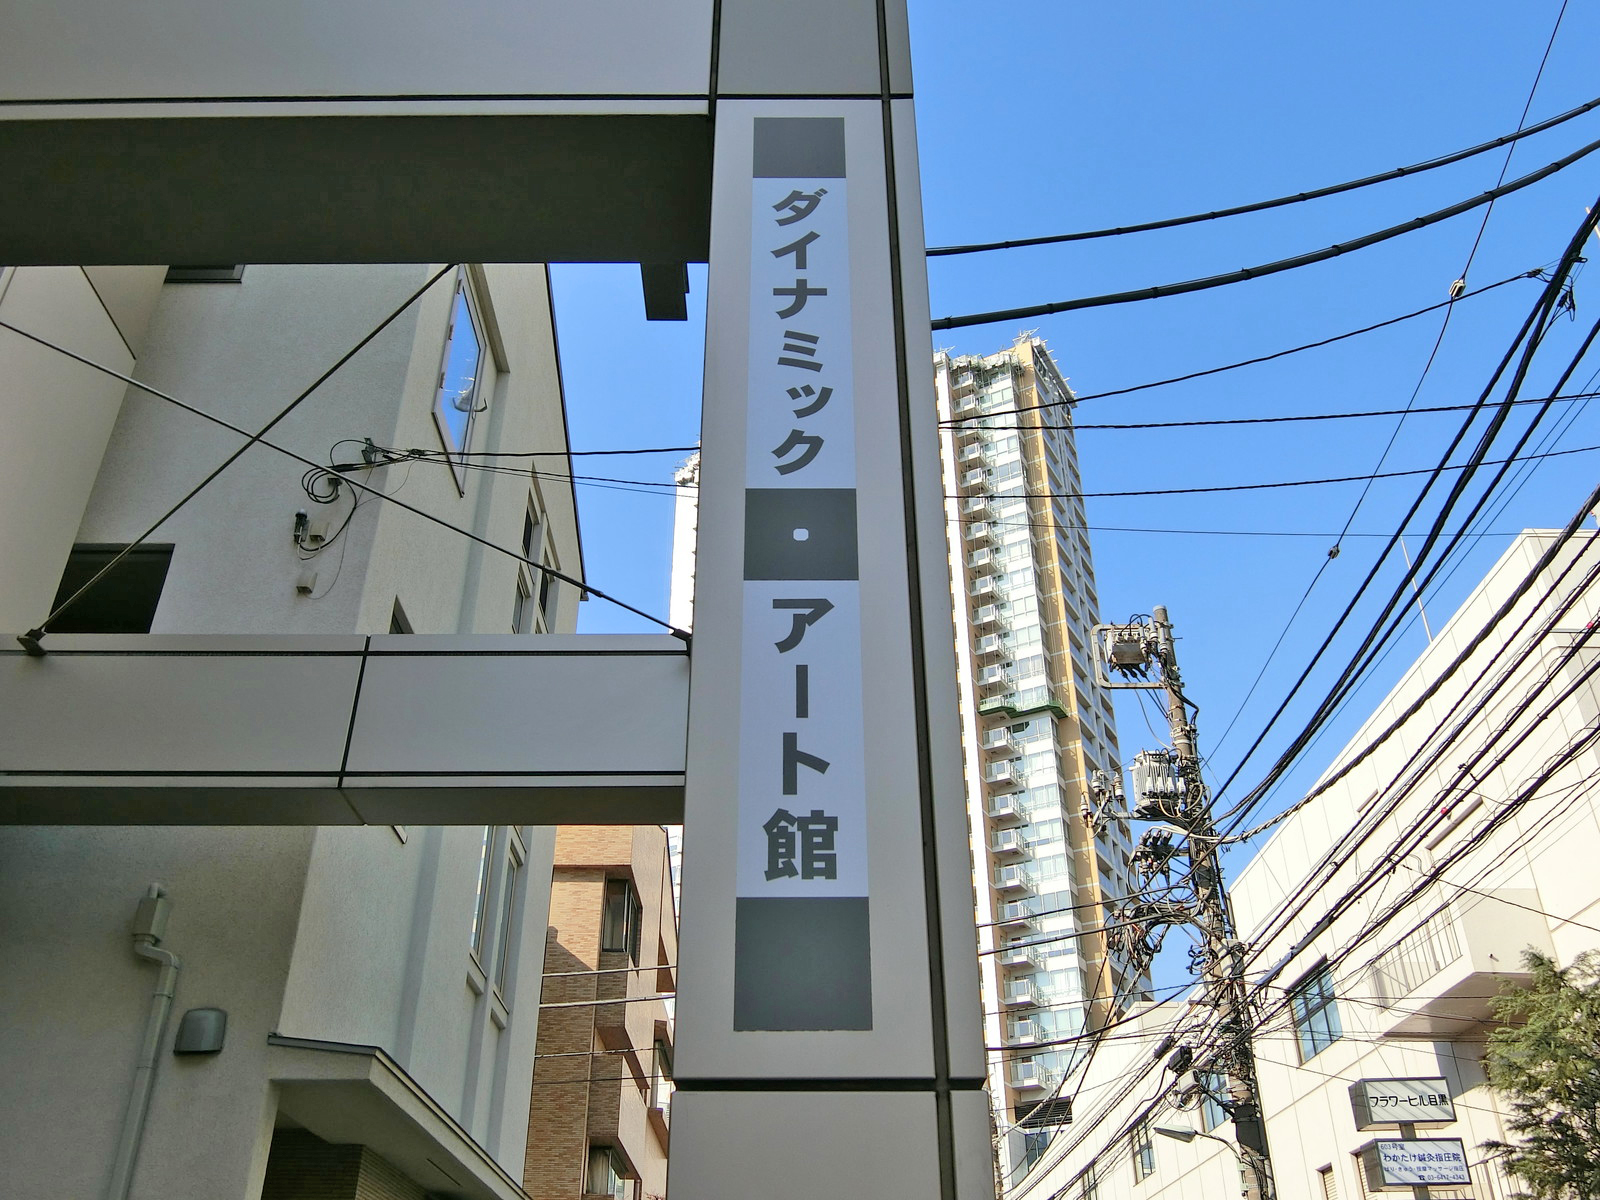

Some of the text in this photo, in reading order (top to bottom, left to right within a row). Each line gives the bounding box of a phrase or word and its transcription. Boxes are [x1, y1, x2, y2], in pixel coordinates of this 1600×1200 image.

[762, 187, 839, 881] ダイナミック・アート館
[1369, 1094, 1449, 1107] フラワーヒル目黒
[1383, 1152, 1462, 1162] わかたけ鍼灸指圧院
